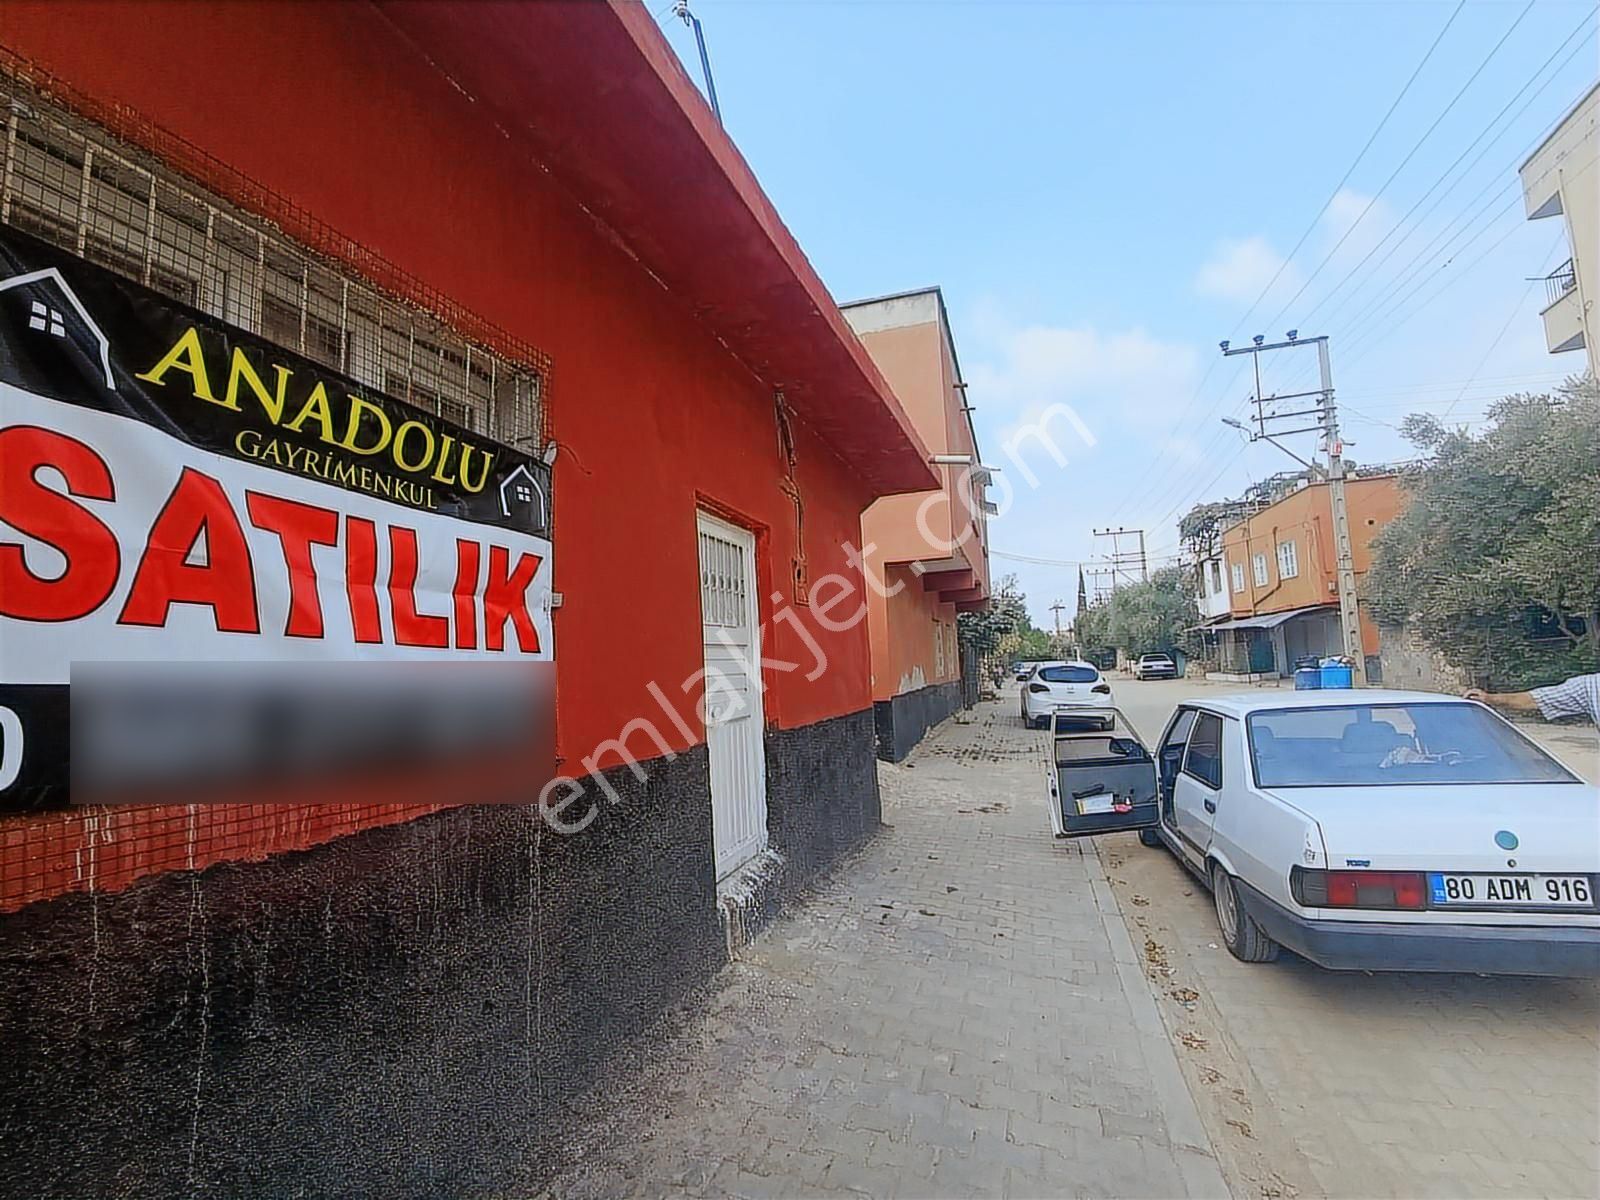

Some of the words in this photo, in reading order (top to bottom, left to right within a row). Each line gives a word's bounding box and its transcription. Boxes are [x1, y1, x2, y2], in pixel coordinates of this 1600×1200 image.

[135, 326, 494, 493] ANADOLU
[235, 430, 438, 509] GAYRİMENKUL
[0, 425, 543, 653] SATILIK
[1446, 878, 1474, 899] 80
[1487, 878, 1531, 900] ADM
[1545, 879, 1588, 901] 916
